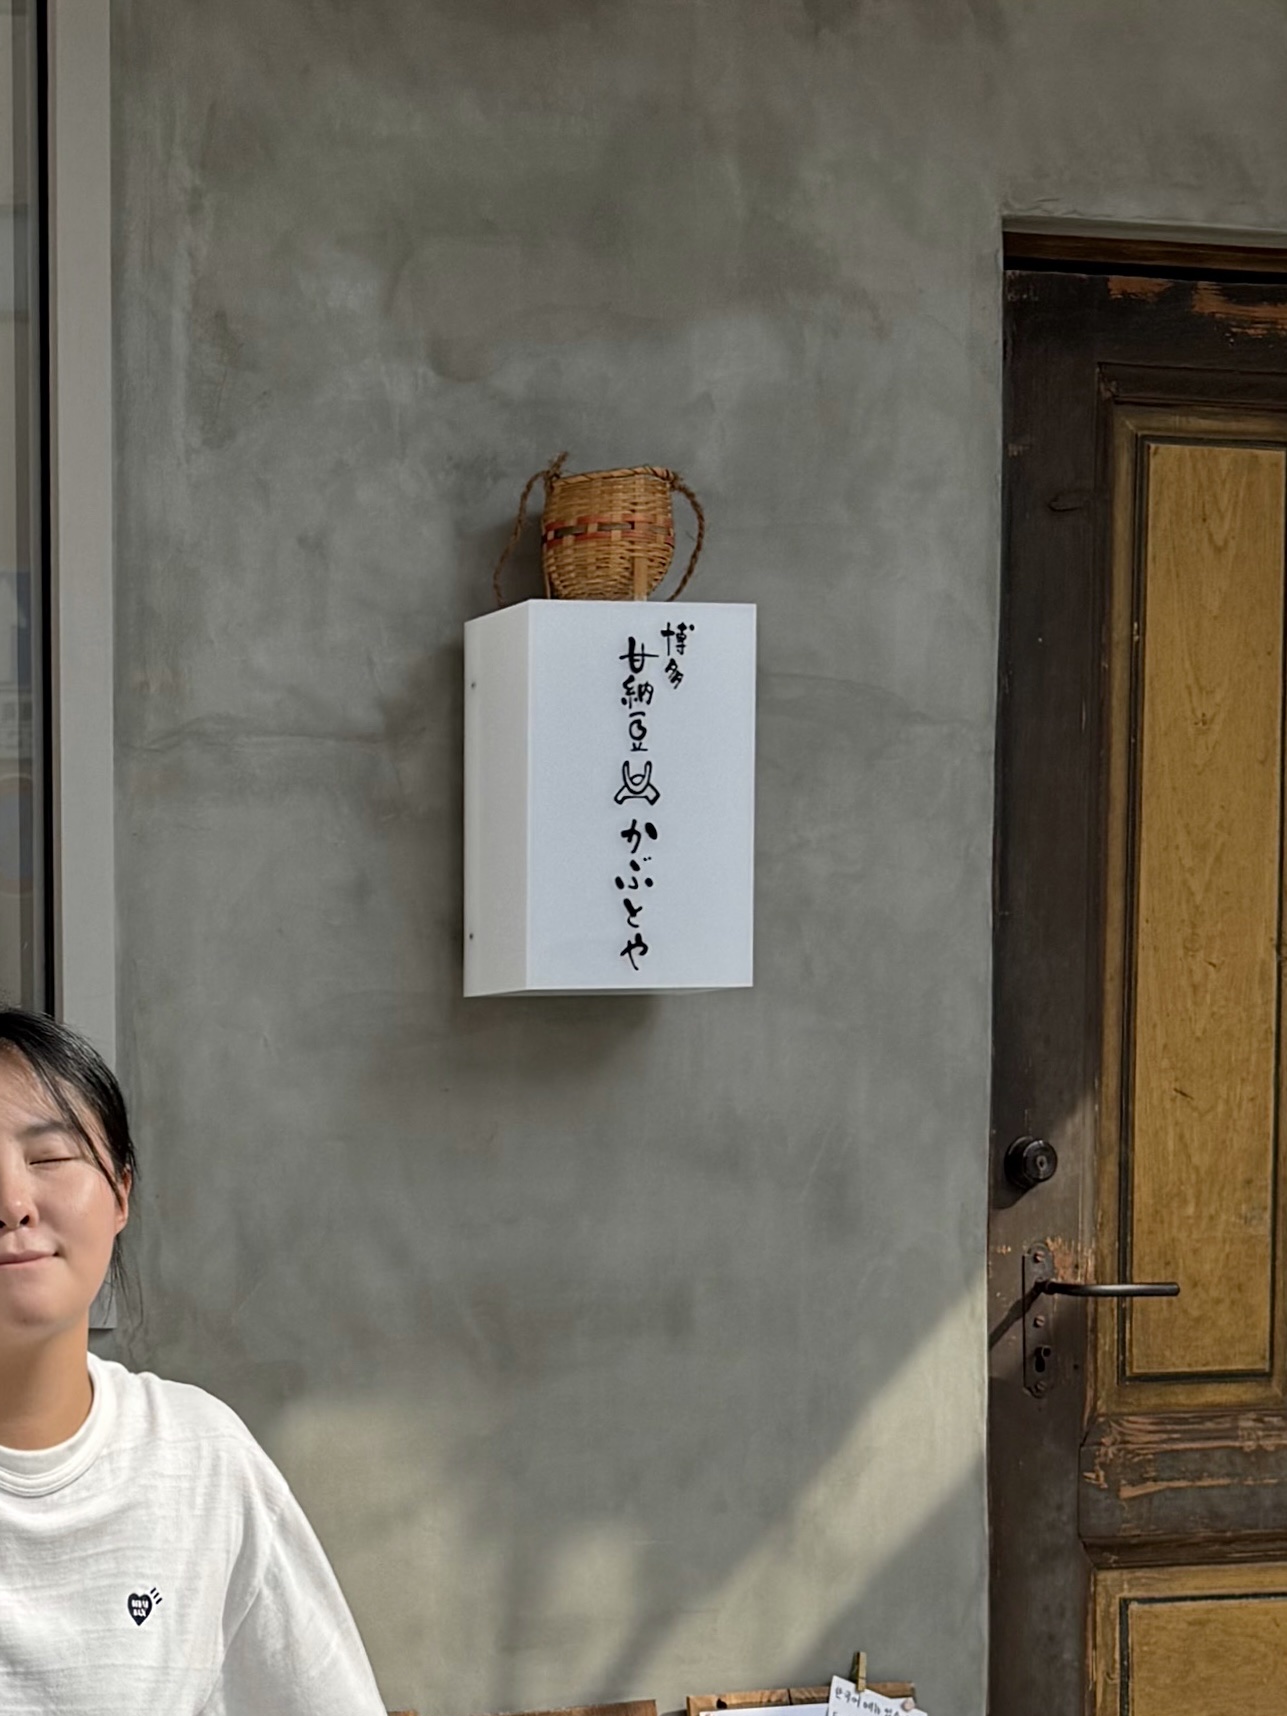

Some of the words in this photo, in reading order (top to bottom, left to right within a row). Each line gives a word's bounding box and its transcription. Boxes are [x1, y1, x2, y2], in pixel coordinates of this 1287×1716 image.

[614, 818, 659, 972] かぶとや
[834, 1686, 861, 1708] 한국어
